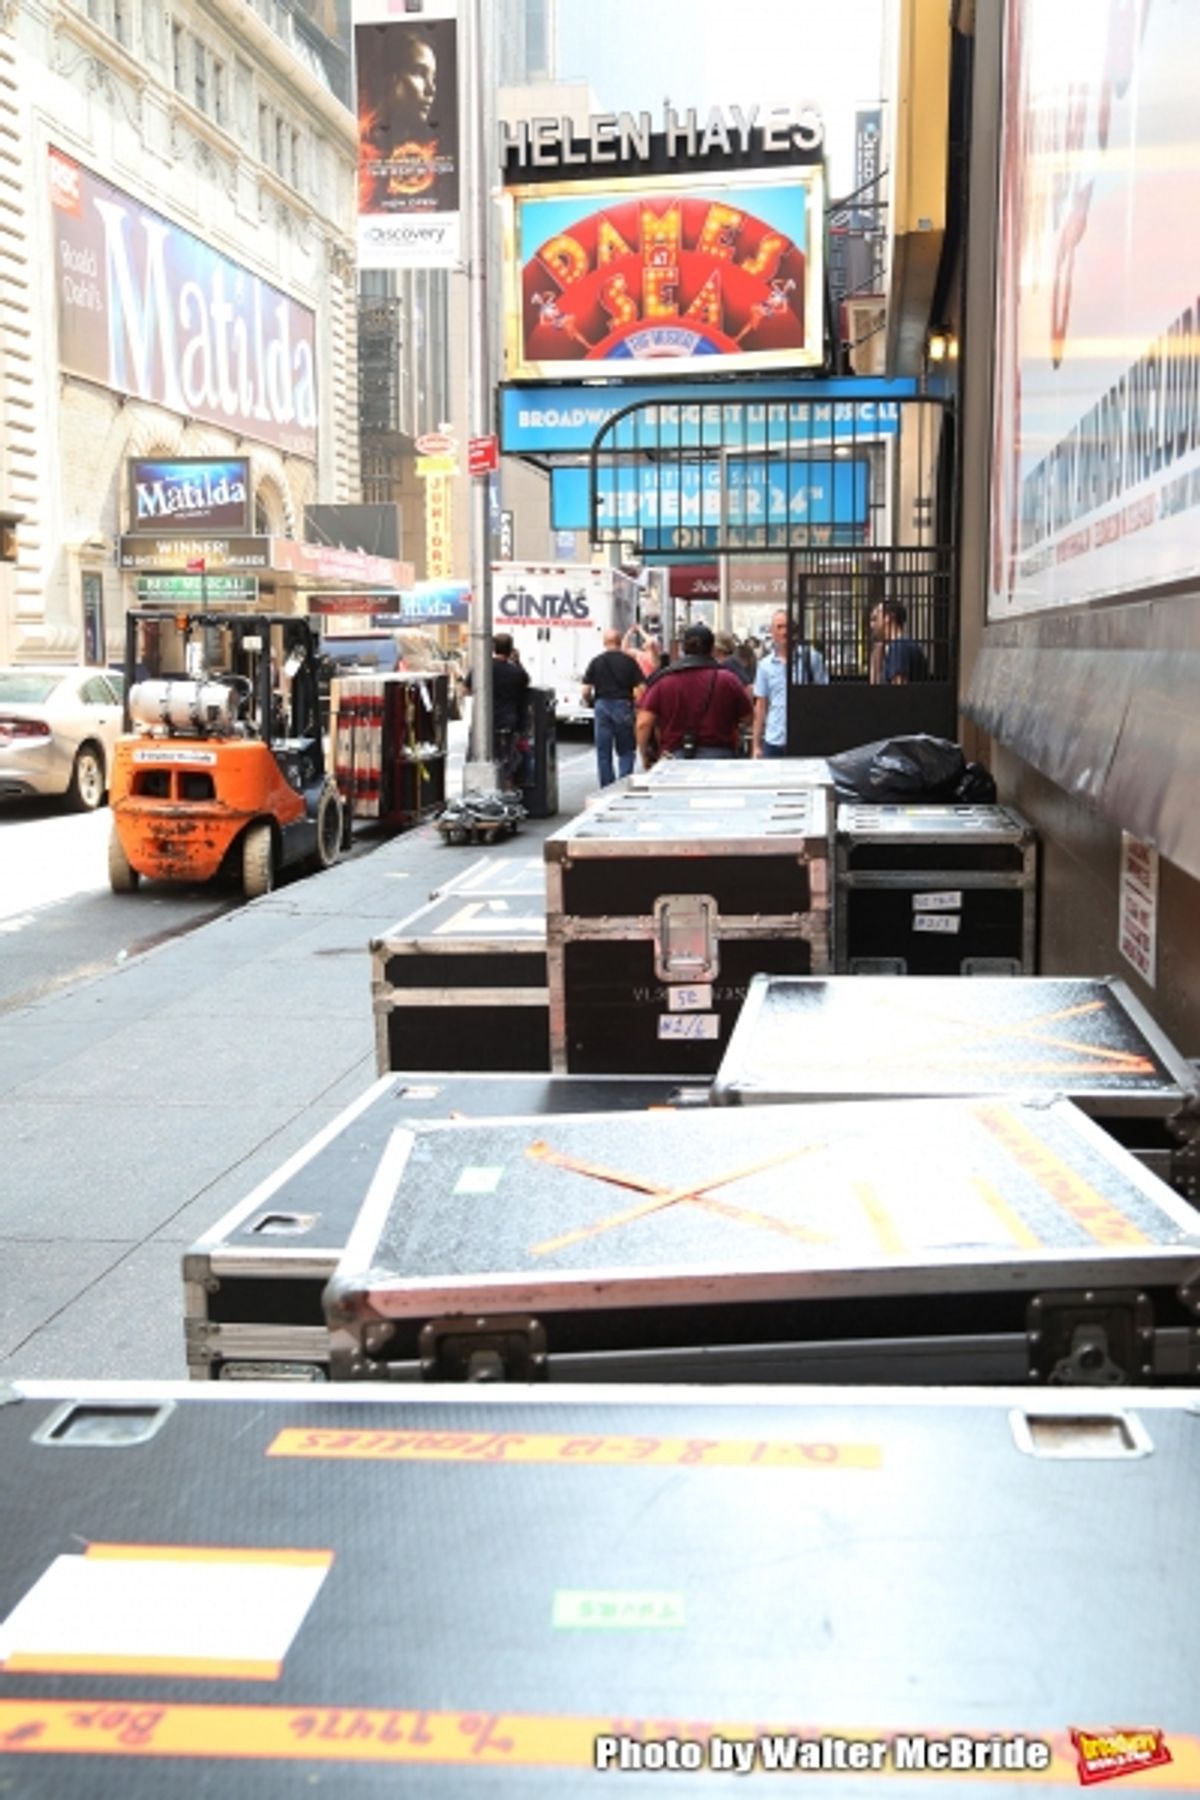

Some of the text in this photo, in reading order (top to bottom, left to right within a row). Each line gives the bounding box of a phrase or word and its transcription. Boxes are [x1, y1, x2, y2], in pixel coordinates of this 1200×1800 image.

[498, 98, 823, 168] HELEN HAYES
[535, 197, 792, 292] DAMES
[93, 197, 317, 428] Matilda
[600, 264, 724, 332] SEA
[747, 401, 809, 421] LITTLE
[814, 398, 899, 420] MUSICAL
[136, 470, 246, 518] Matilda
[498, 588, 590, 620] CINTAS
